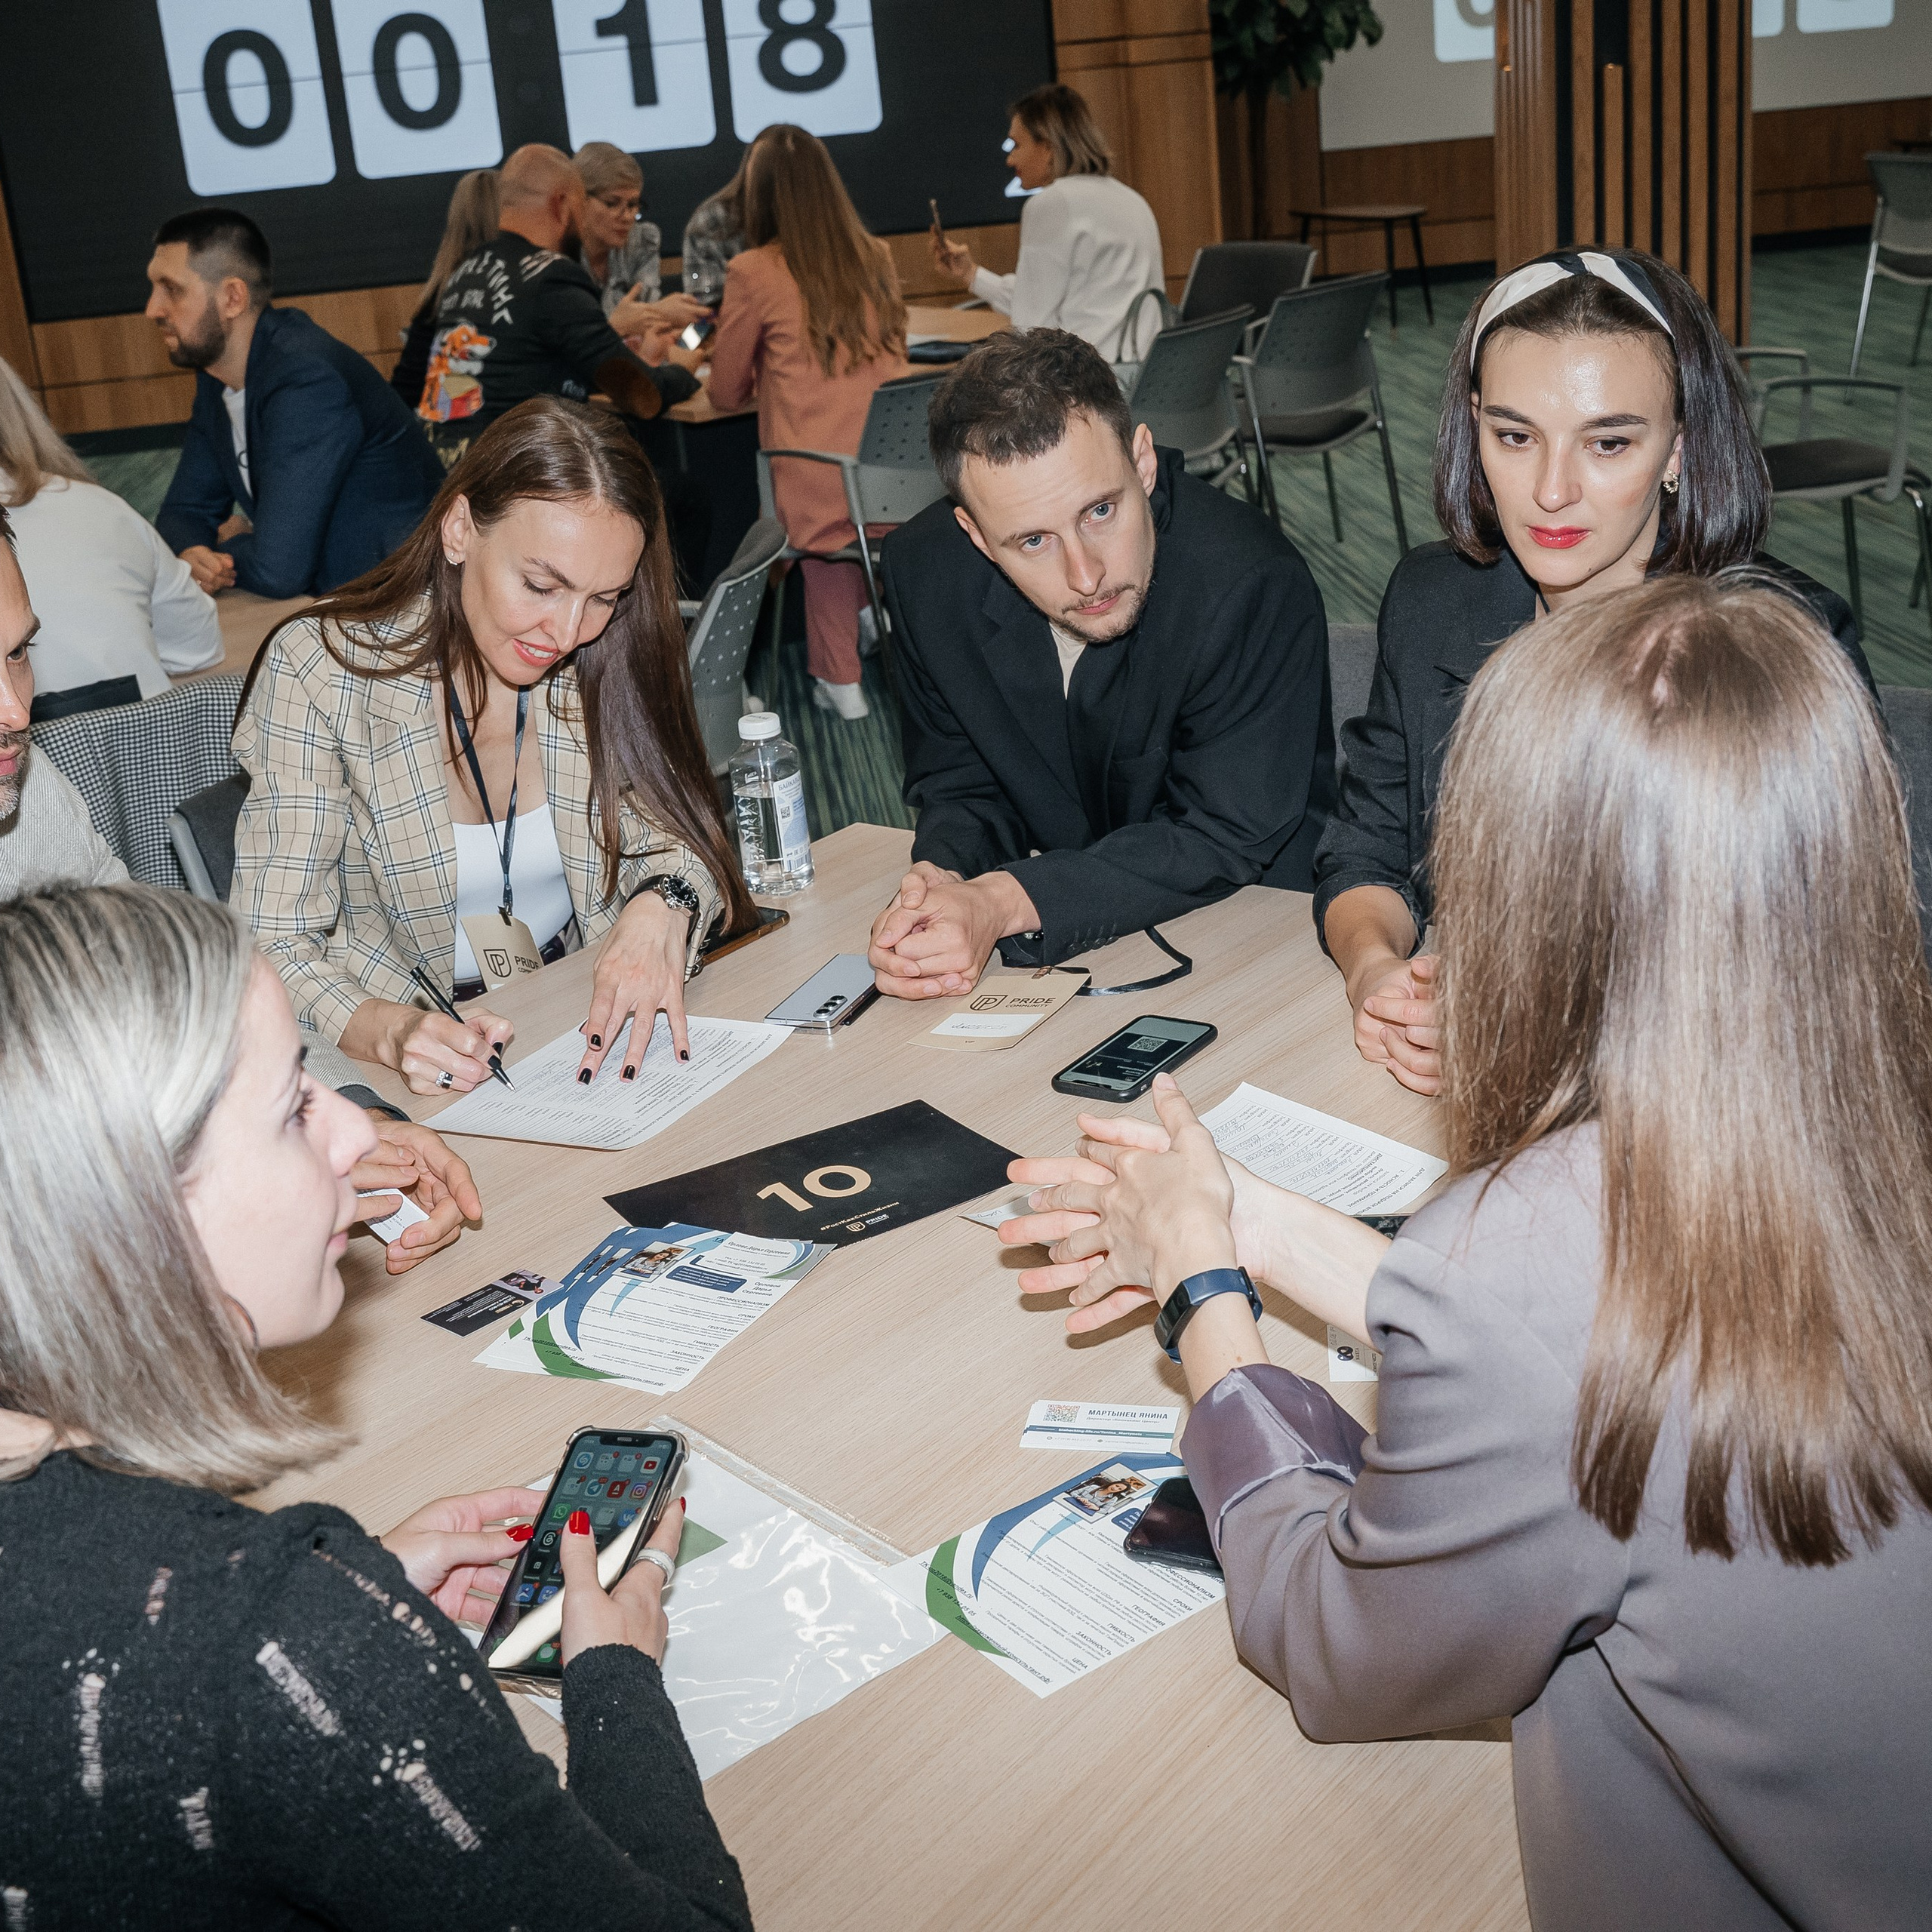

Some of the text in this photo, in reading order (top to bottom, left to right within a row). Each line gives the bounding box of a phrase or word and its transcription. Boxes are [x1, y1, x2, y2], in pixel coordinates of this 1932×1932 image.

[514, 955, 540, 970] PRIDE
[1415, 1168, 1425, 1177] ДЛЯ
[1379, 1174, 1399, 1188] ЯСНОСТЬ
[1398, 1177, 1416, 1190] ЗАПИСИ
[756, 1165, 872, 1211] 10
[820, 1201, 900, 1231] #РостКакСтильЖизни
[866, 1214, 888, 1223] PRIDE
[728, 1240, 747, 1250] Орлова
[746, 1243, 762, 1253] Дарья
[762, 1247, 791, 1256] Сергеевна
[716, 1295, 770, 1307] ПРОФЕССИОНАЛИЗМ
[707, 1324, 740, 1334] ГЕОГРАФИЯ
[692, 1340, 720, 1348] ГИБКОСТЬ
[670, 1349, 706, 1361] ЗАКОННОСТЬ
[1088, 1410, 1137, 1418] МАРТЫНЕЦ
[1173, 1599, 1192, 1611] СРОКИ
[1132, 1605, 1165, 1626] ГЕОГРАФИЯ
[1108, 1623, 1134, 1641] ГИБКОСТЬ
[1076, 1632, 1111, 1655] ЗАКОННОСТЬ
[1072, 1658, 1088, 1669] ЦЕНА
